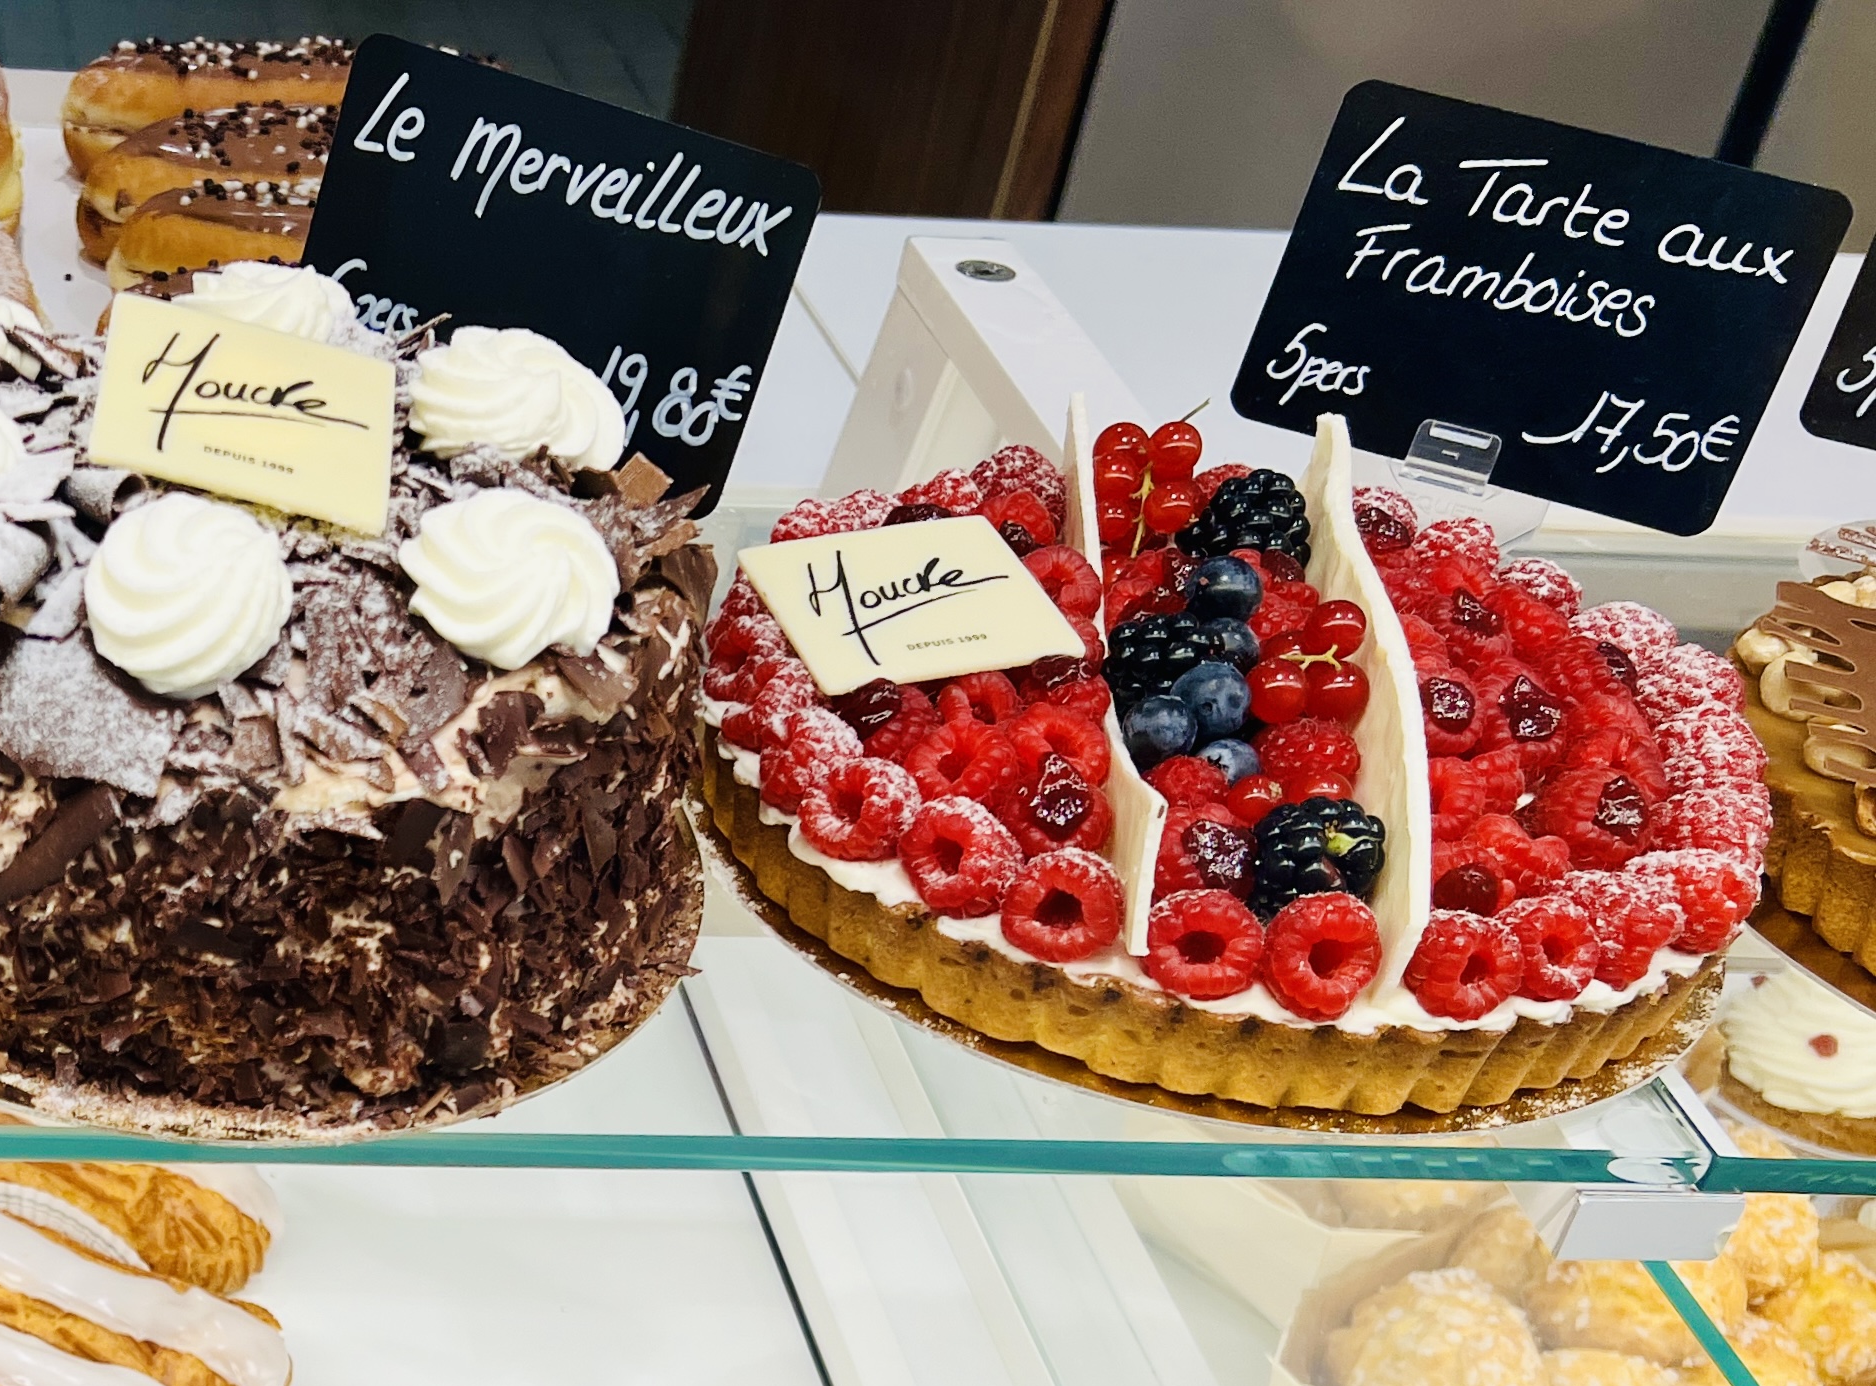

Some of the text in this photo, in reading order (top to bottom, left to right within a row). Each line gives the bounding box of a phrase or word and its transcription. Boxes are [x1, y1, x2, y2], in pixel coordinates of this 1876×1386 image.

[353, 72, 793, 257] Le Merveilleux
[1337, 116, 1795, 285] La Tarte aux
[1345, 222, 1656, 338] Framboises
[1521, 389, 1741, 474] 17,50€
[906, 633, 988, 652] DEPUIS 1999
